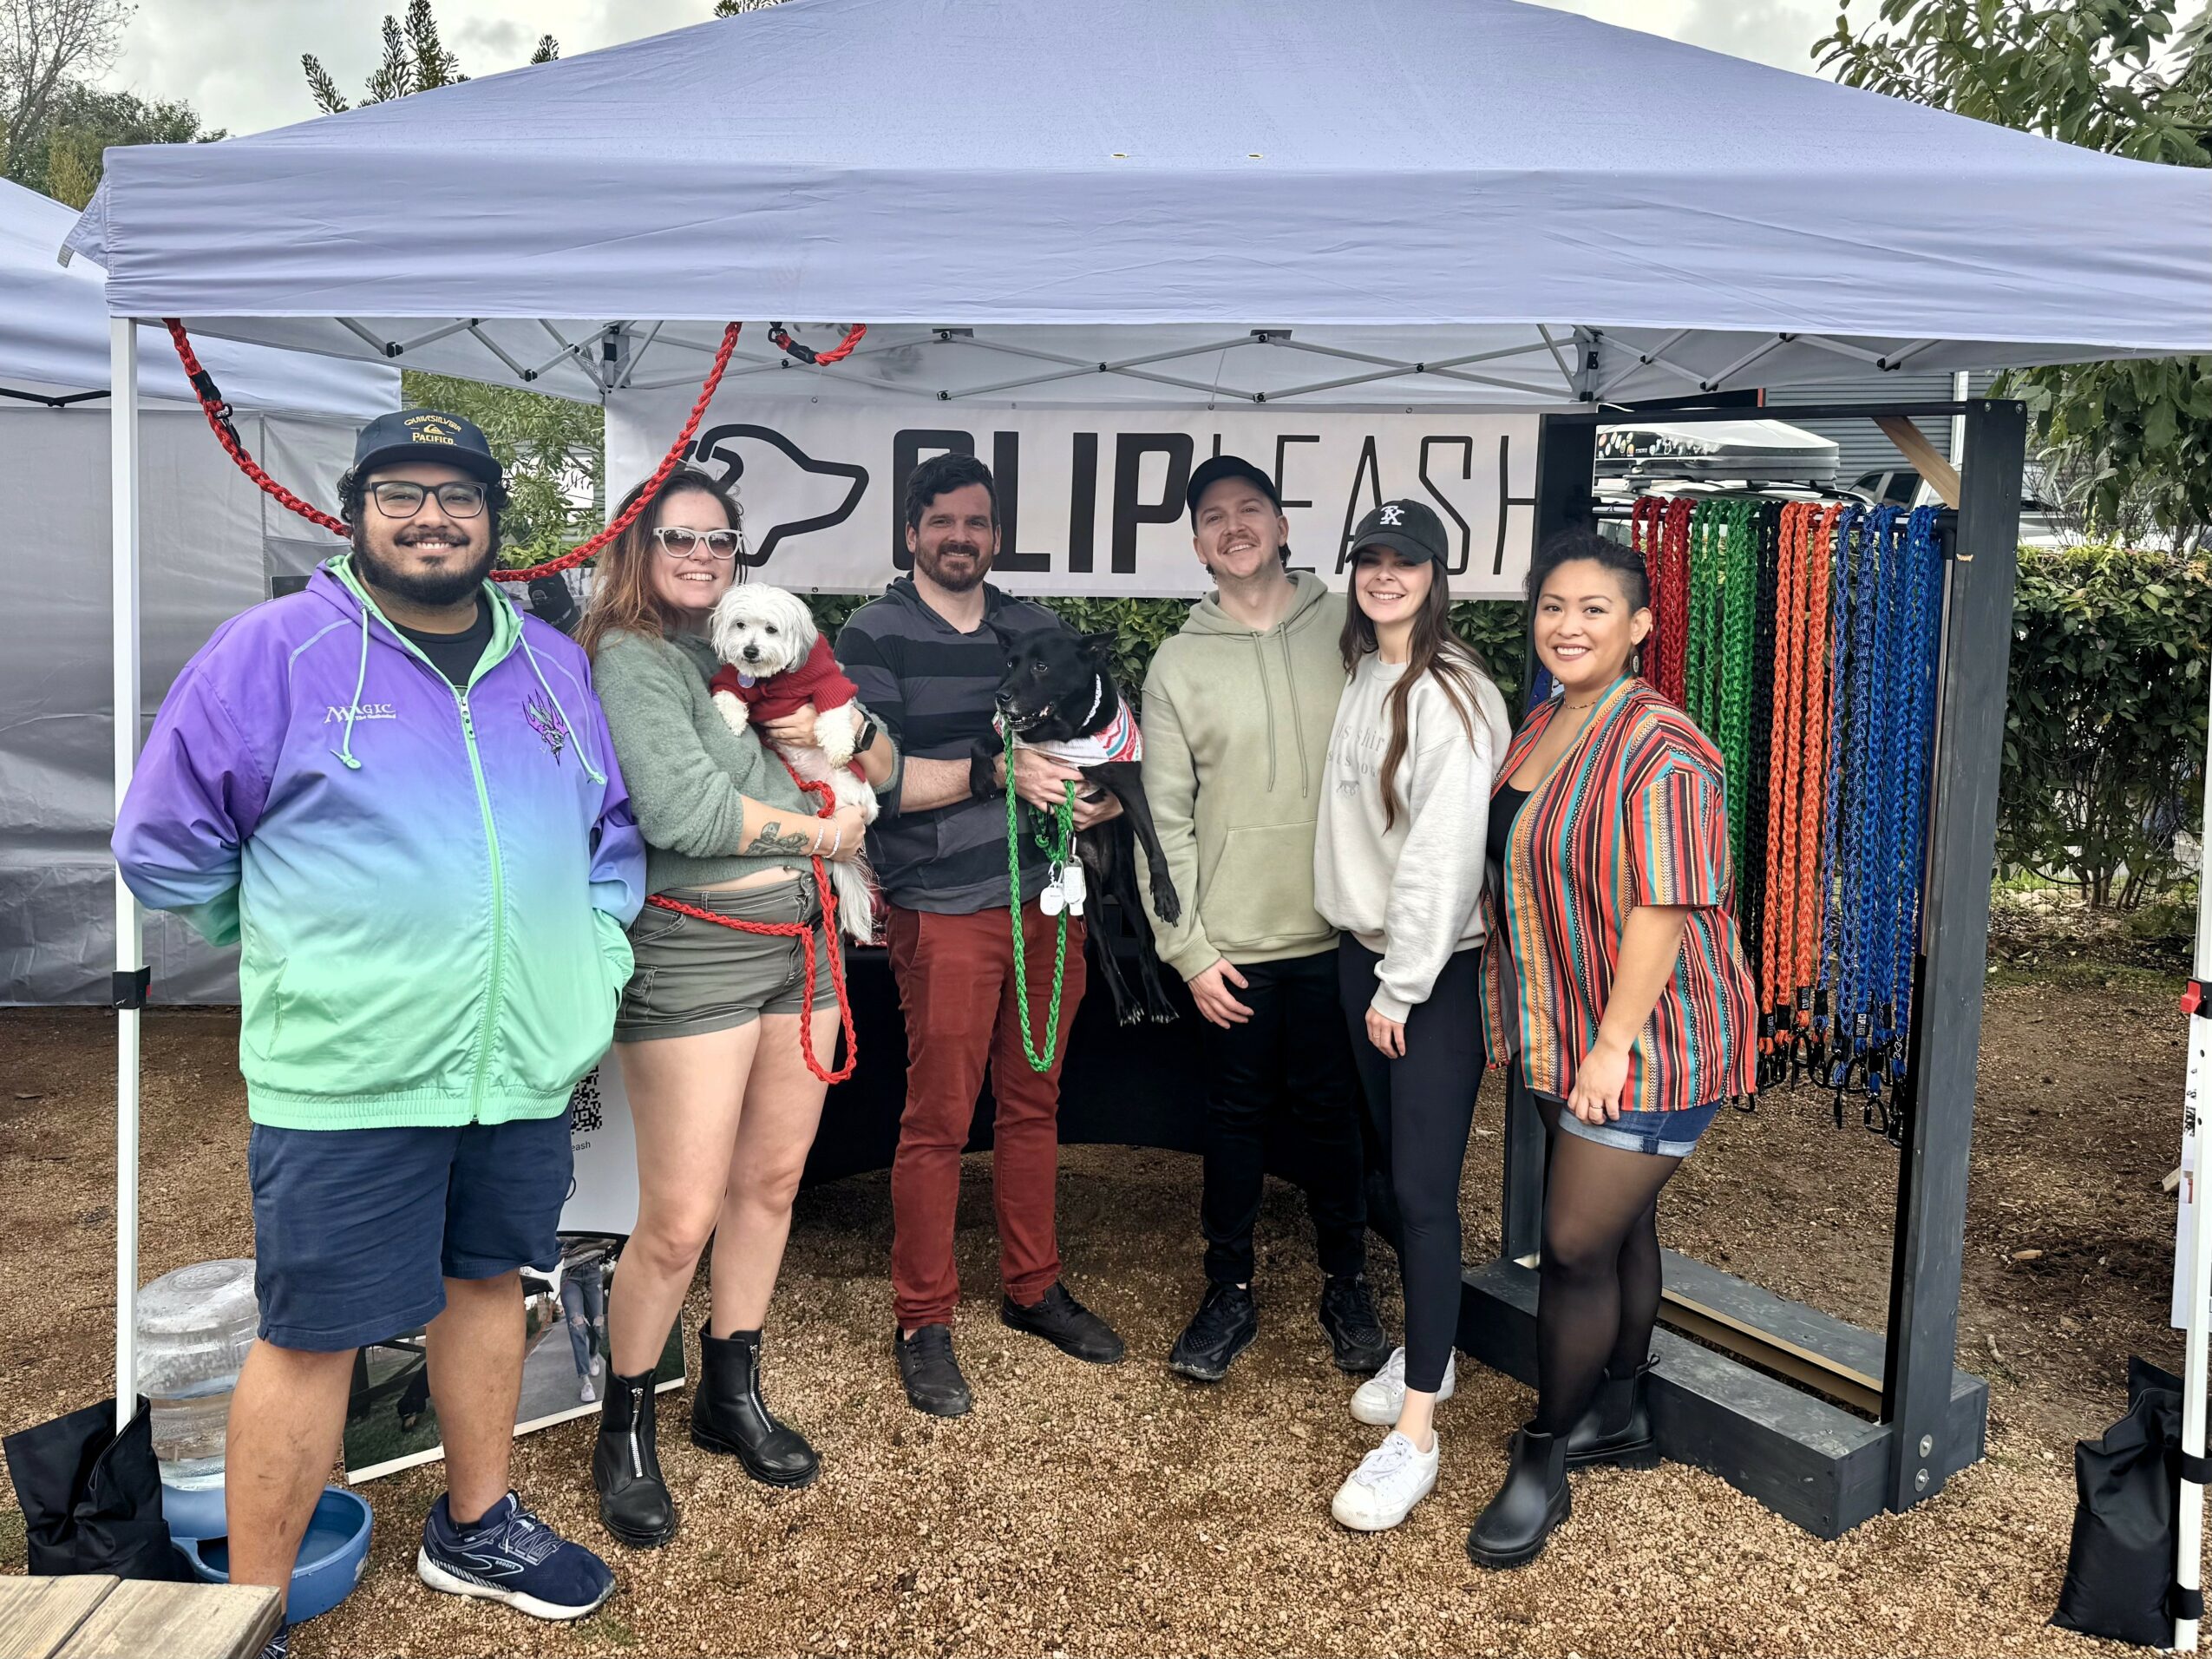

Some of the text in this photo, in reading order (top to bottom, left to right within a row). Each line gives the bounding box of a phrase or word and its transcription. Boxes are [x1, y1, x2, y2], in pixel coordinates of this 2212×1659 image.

[403, 415, 461, 432] QUIKSILVER
[412, 432, 454, 445] PACIFICO
[893, 430, 1535, 574] CLIPEASH
[495, 1560, 515, 1570] BROOKS
